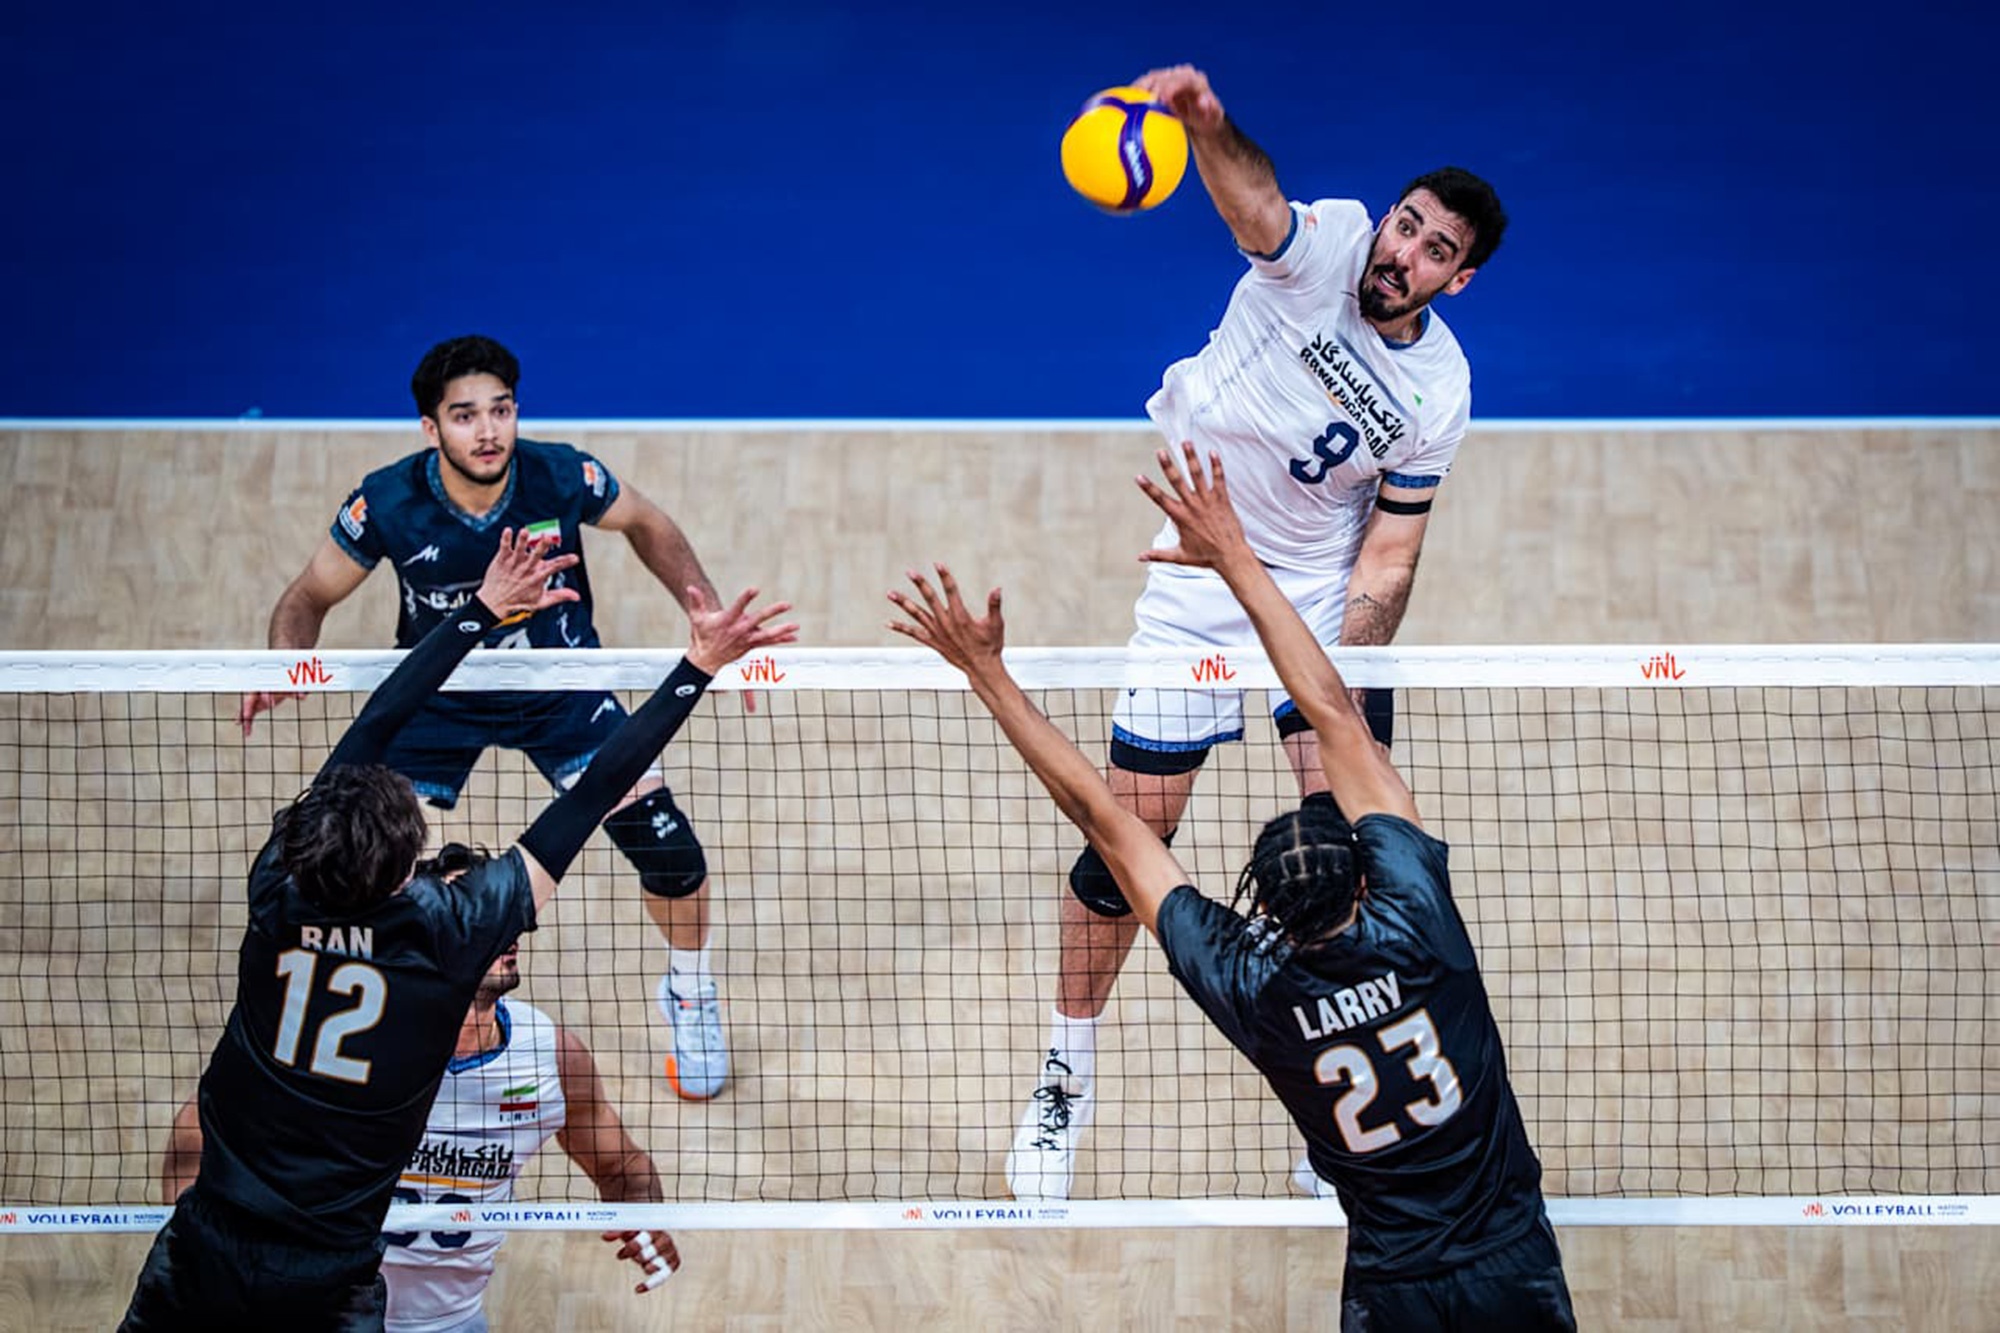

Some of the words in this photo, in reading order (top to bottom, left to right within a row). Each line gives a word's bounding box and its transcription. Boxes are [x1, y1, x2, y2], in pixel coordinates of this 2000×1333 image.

[1289, 421, 1360, 484] 9
[288, 656, 333, 686] VNL
[741, 656, 785, 683] VNL
[1191, 654, 1237, 682] VNL
[1641, 652, 1686, 680] VNL
[274, 946, 389, 1085] 12
[1293, 970, 1402, 1041] LARRY
[1314, 1007, 1463, 1153] 23
[27, 1213, 129, 1224] VOLLEYBALL
[481, 1211, 580, 1222] VOLLEYBALL
[933, 1209, 1032, 1219] VOLLEYBALL
[1832, 1204, 1933, 1215] VOLLEYBALL
